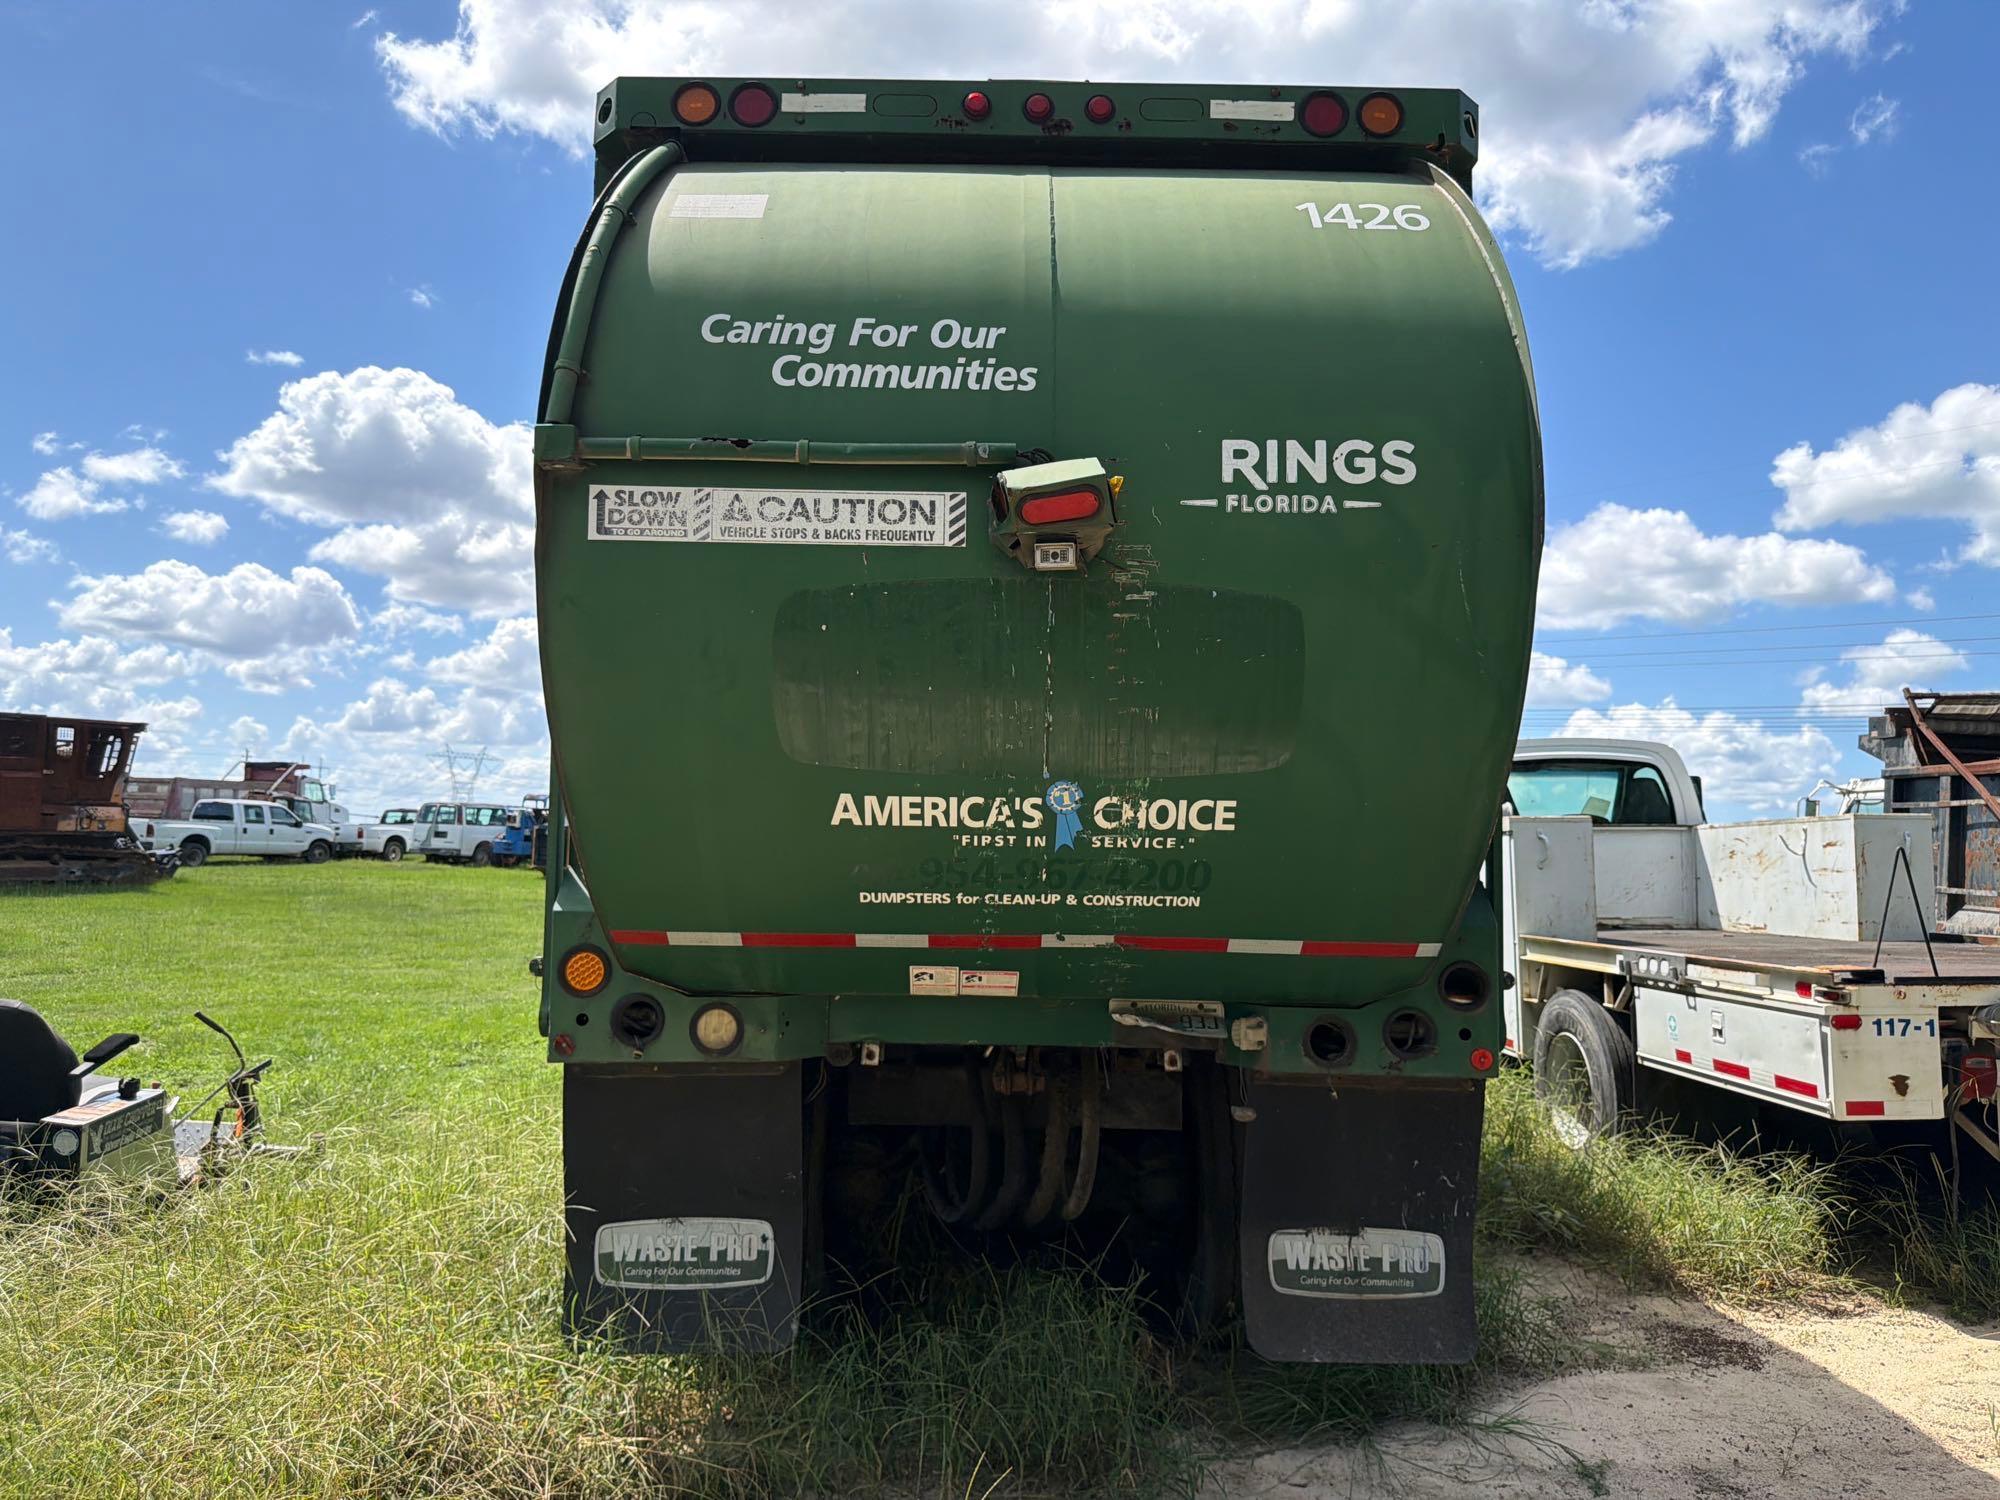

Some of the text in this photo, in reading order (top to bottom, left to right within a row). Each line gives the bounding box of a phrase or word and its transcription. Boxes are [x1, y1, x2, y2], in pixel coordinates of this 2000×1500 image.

[1295, 202, 1431, 231] 1426
[700, 313, 1007, 354] Caring For Our
[771, 354, 1038, 392] Communities
[1221, 439, 1418, 491] RINGS
[613, 489, 682, 508] SLOW
[1225, 494, 1338, 514] FLORIDA
[607, 508, 688, 527] DOWN
[756, 495, 937, 526] CAUTION
[612, 528, 685, 537] TO GO AROUND
[719, 526, 936, 542] VEHICLE STOPS & BACKS FREQUENTLY
[830, 792, 1044, 829] AMERICA'S
[1093, 796, 1238, 832] CHOICE
[1026, 835, 1047, 848] IN
[859, 891, 1201, 908] DUMPSTERS for CLEAN-UP & CONSTRUCTION
[1872, 1017, 1936, 1038] 117-1
[613, 1231, 758, 1263] WASTE PRO
[1284, 1239, 1430, 1274] WASTE PRO
[625, 1266, 742, 1277] Caring For Our Communities
[1300, 1275, 1415, 1288] Caring For Our Communities
